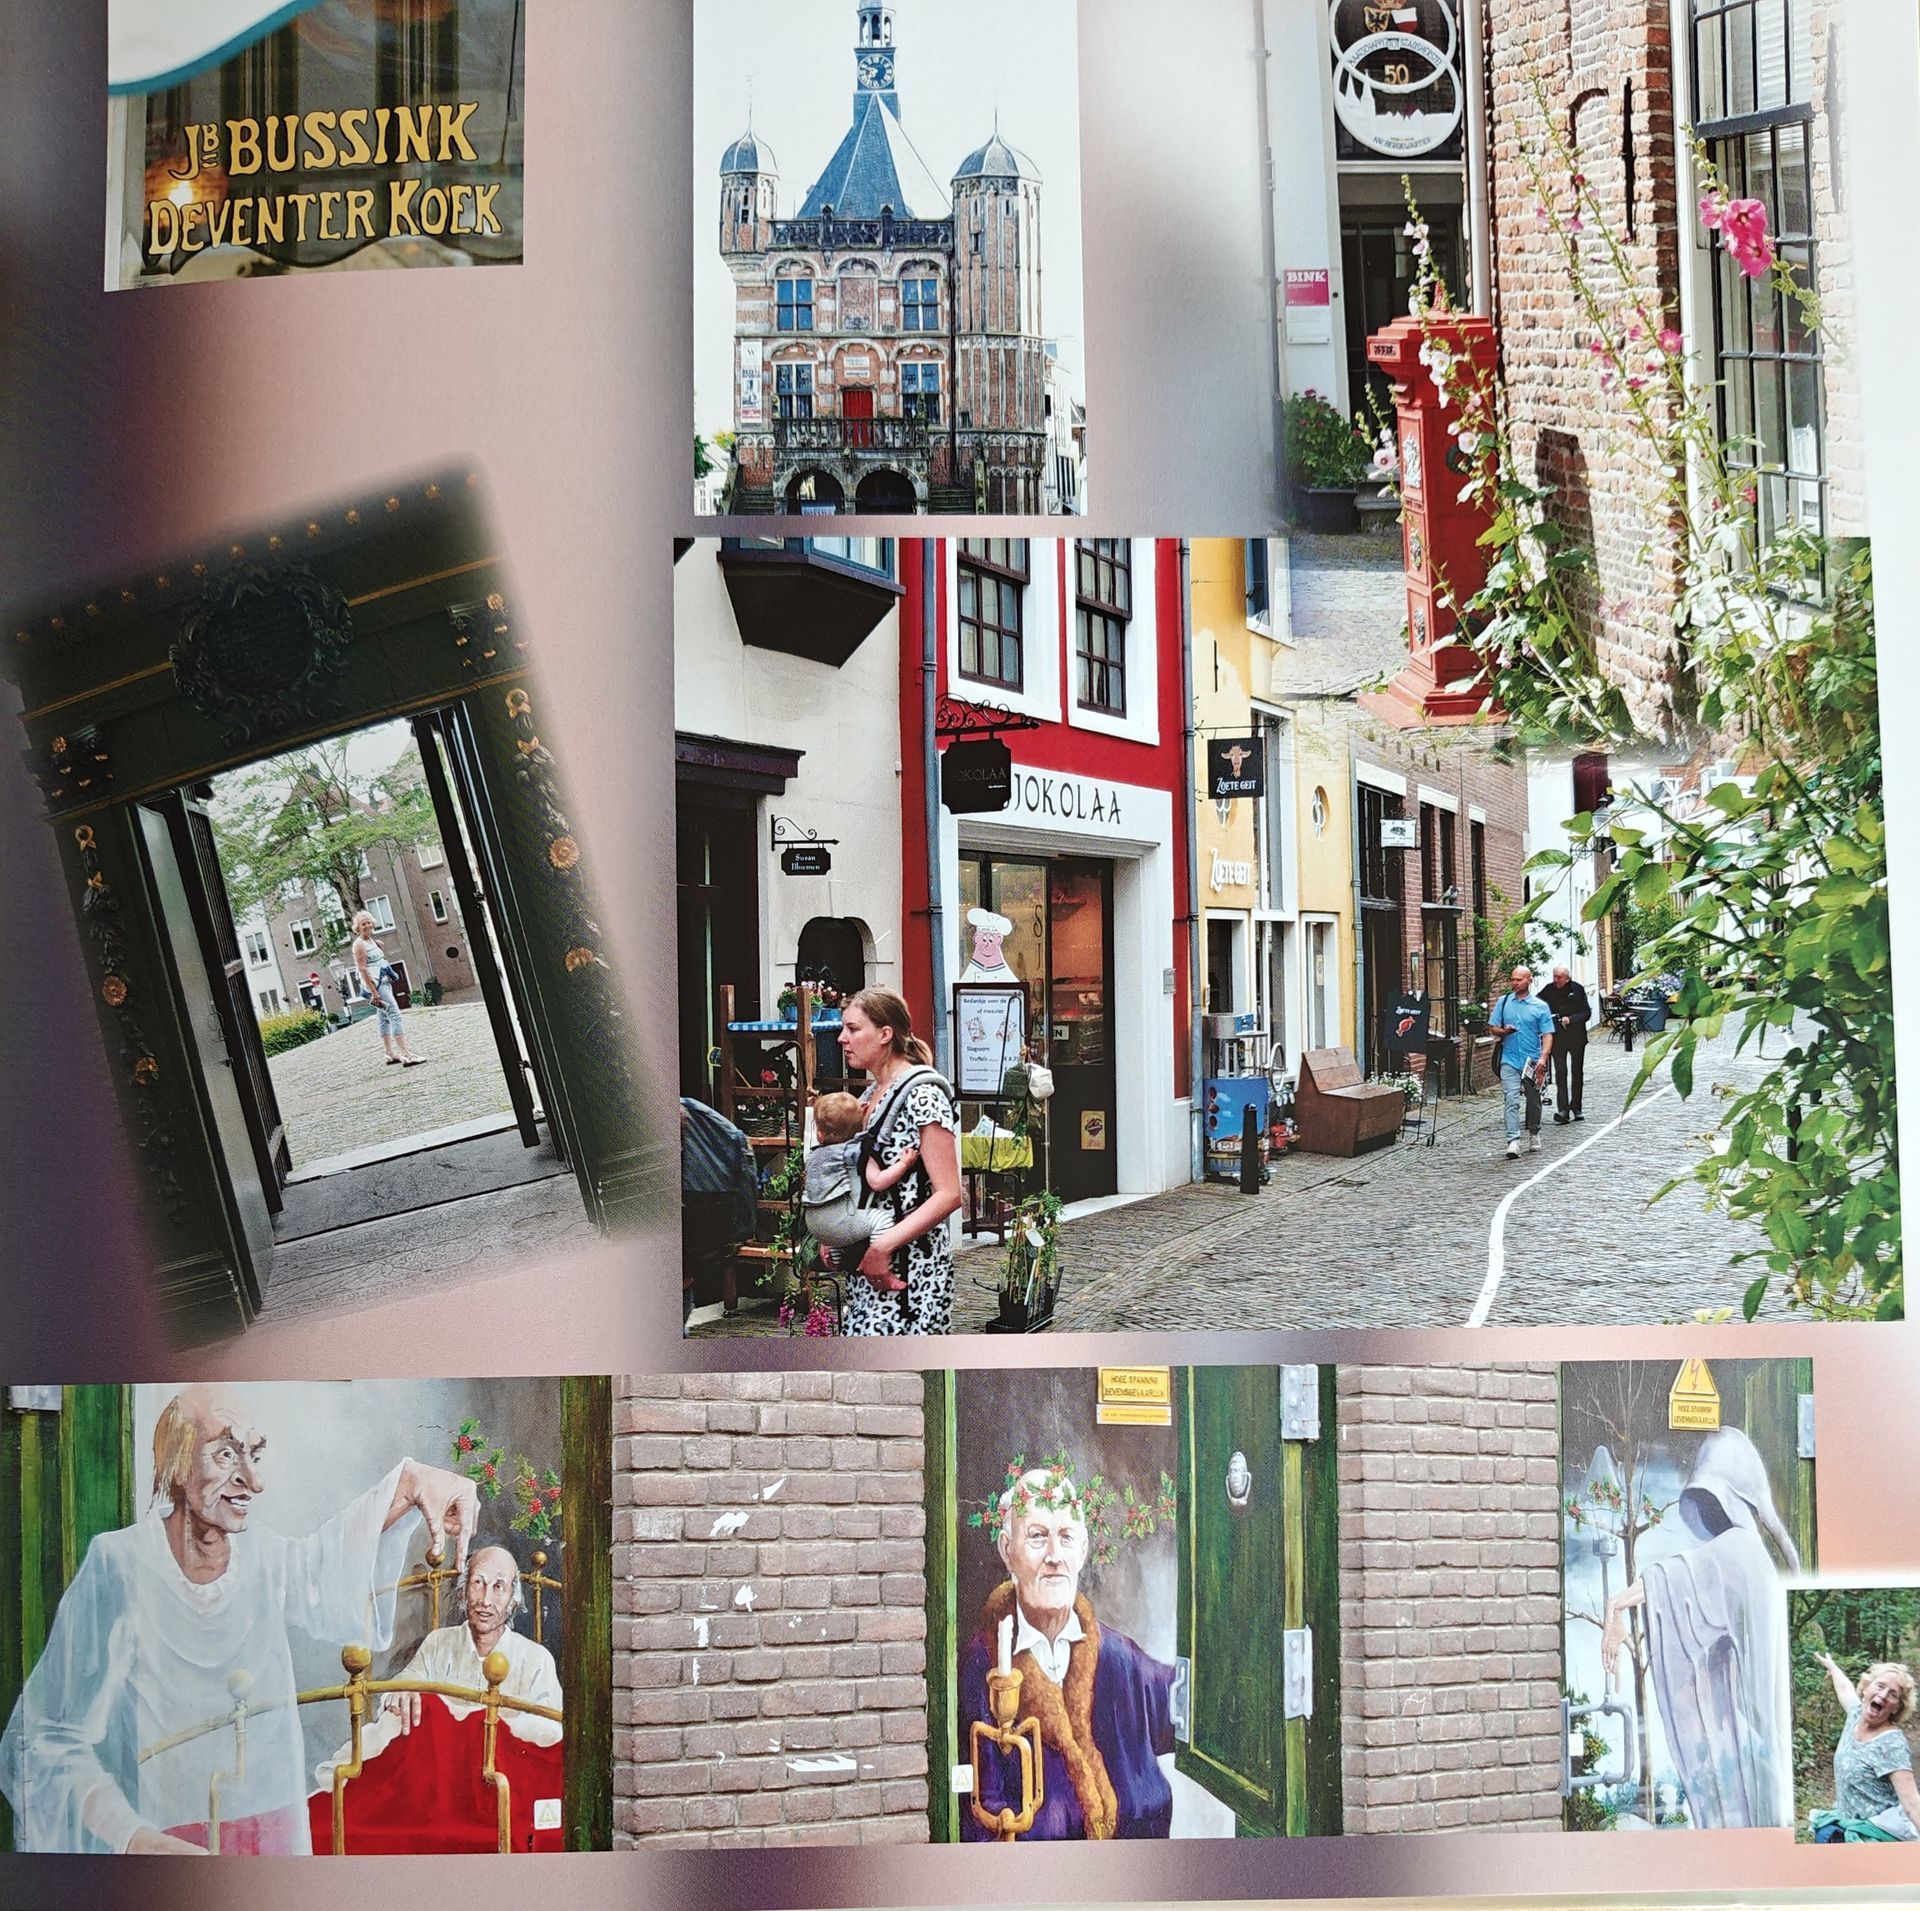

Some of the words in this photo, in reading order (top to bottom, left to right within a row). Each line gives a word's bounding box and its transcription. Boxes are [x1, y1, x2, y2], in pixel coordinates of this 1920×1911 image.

[1384, 63, 1409, 84] 50
[226, 102, 480, 176] BUSSINK
[147, 188, 376, 256] DEVENTER
[387, 178, 503, 238] KOEK
[1286, 271, 1327, 283] BINK
[1003, 773, 1122, 825] JOKOLAA
[1216, 777, 1239, 795] ZOETE
[1239, 779, 1257, 790] GEIT
